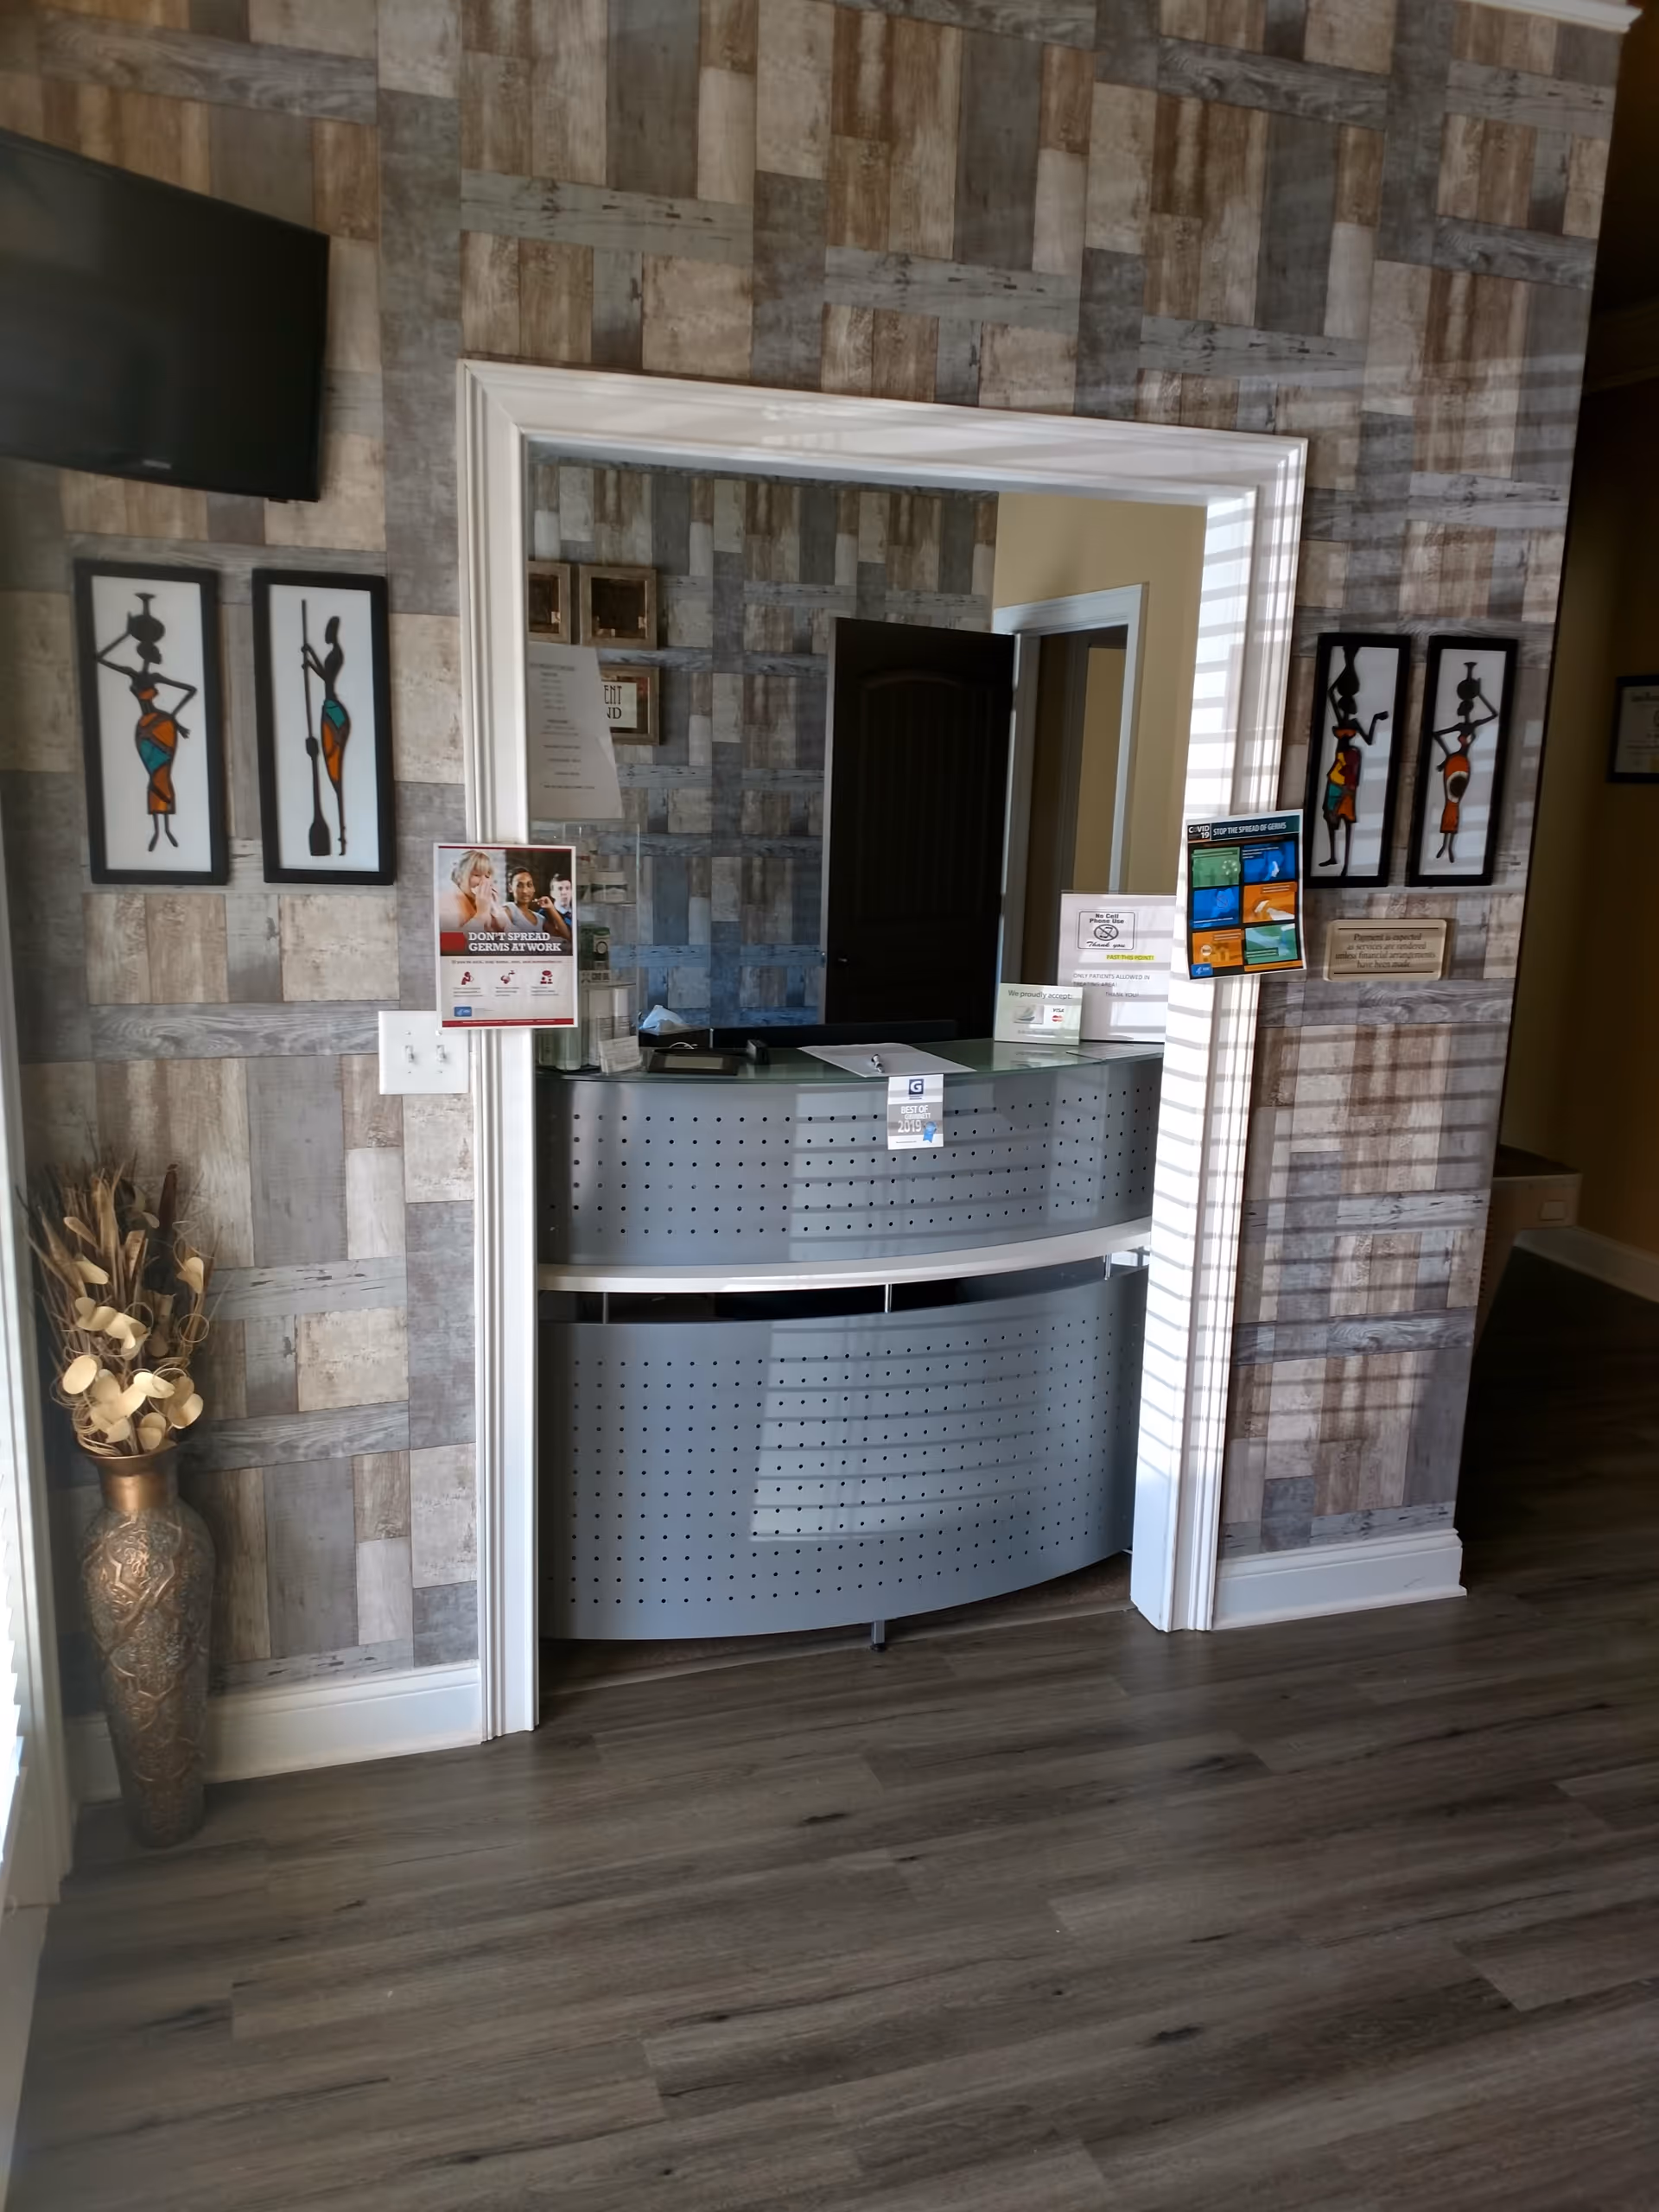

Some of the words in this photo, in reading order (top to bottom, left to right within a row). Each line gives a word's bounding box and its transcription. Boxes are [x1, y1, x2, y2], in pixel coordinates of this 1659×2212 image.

[1213, 827, 1227, 836] STOP
[1238, 824, 1259, 833] SPREAD
[1268, 822, 1287, 830] GERMS
[468, 932, 506, 941] DON'T
[507, 932, 550, 941] SPREAD
[468, 943, 510, 951] GERMS
[511, 943, 525, 951] AT
[526, 943, 562, 951] WORK
[910, 1081, 922, 1093] G
[898, 1120, 922, 1133] 2019
